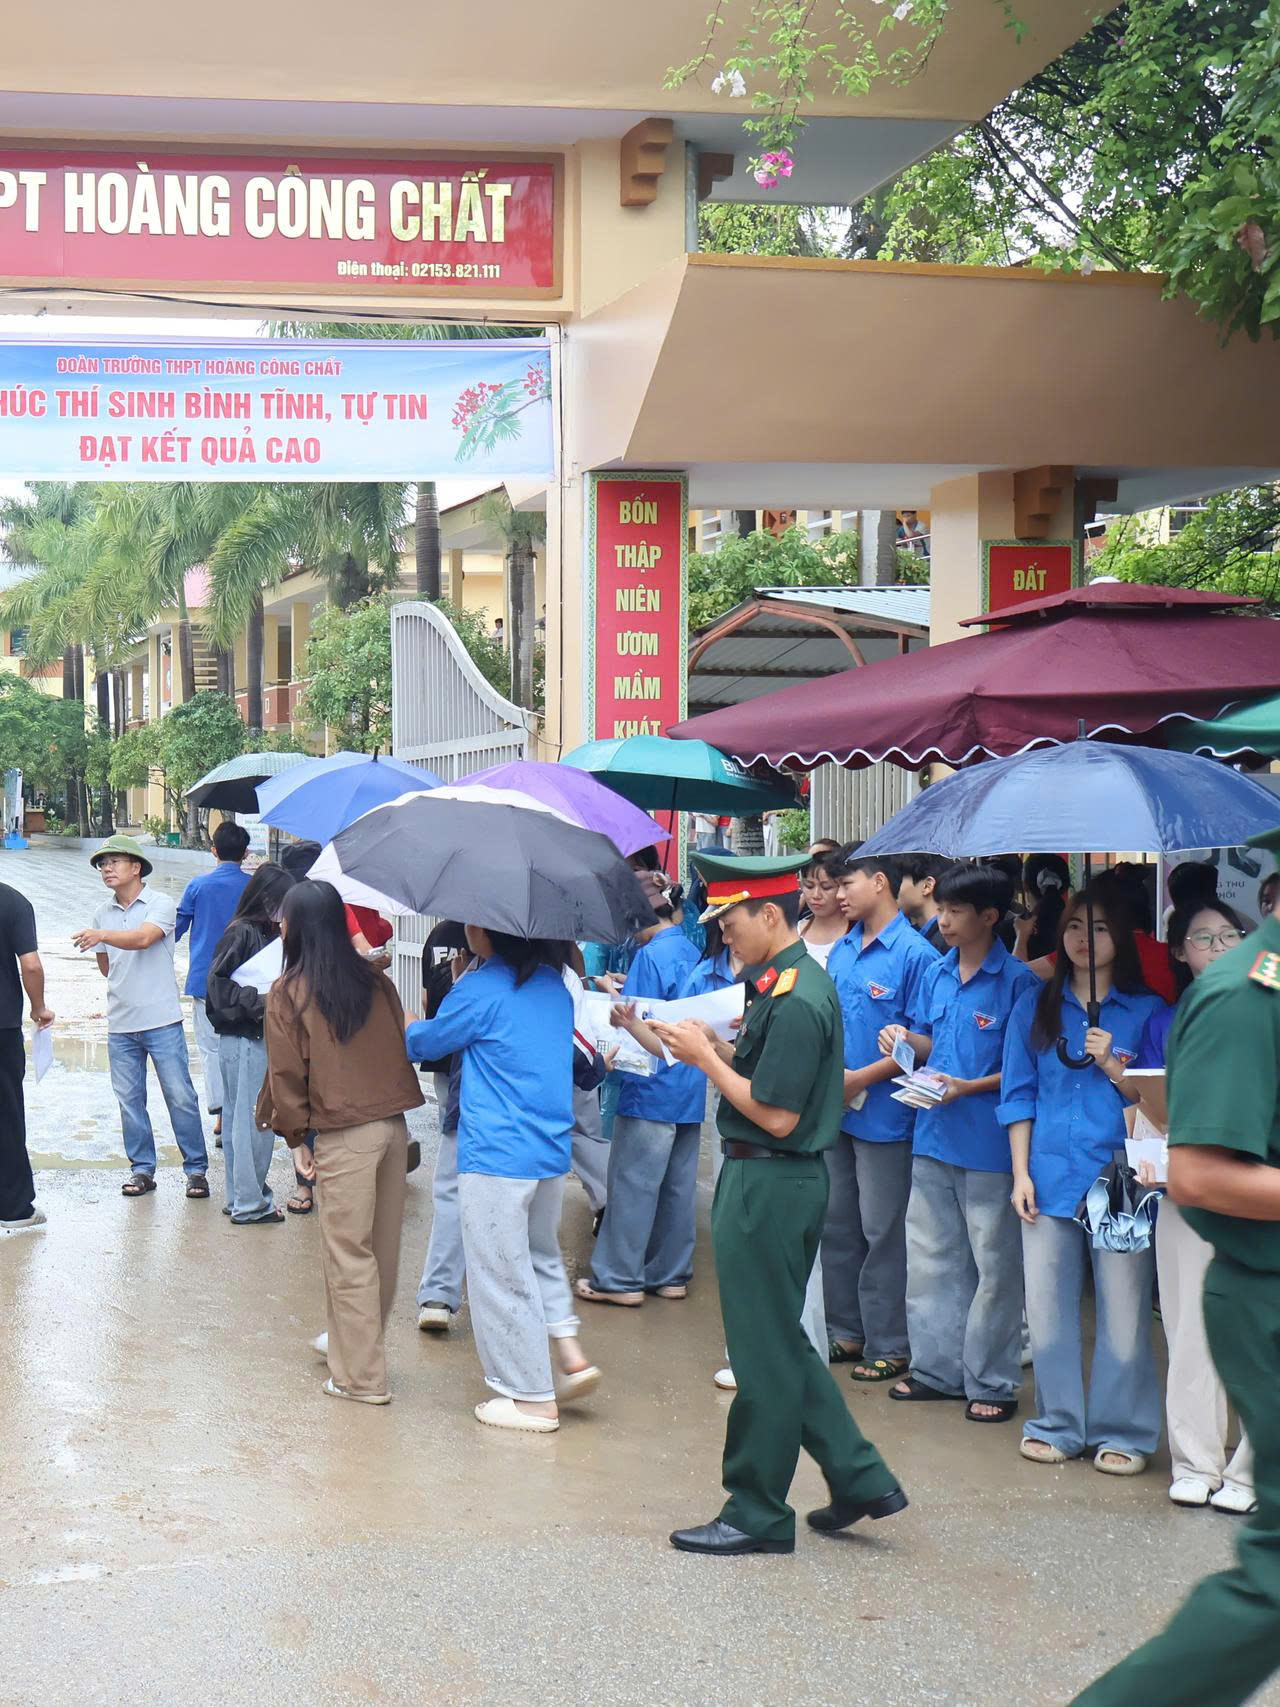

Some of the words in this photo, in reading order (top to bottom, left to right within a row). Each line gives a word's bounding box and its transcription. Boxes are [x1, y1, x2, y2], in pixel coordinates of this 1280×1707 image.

[64, 162, 231, 237] HOÀNG
[244, 164, 375, 242] CÔNG
[389, 168, 513, 243] CHẤT
[337, 260, 367, 279] Điện
[371, 262, 408, 280] thoại:
[411, 263, 500, 278] 02153.821.111
[57, 357, 98, 374] ĐOÀN
[103, 356, 161, 375] TRƯỜNG
[166, 360, 201, 375] THPT
[206, 359, 255, 376] HOÀNG
[260, 360, 299, 376] CÔNG
[304, 357, 342, 376] CHẤT
[56, 386, 98, 417] THÍ
[108, 392, 174, 419] SINH
[188, 386, 250, 420] BÌNH
[260, 390, 331, 424] TĨNH,
[341, 391, 378, 425] TỰ
[385, 393, 427, 420] TIN
[79, 436, 130, 466] ĐẠT
[142, 427, 191, 463] KẾT
[201, 426, 256, 466] QUẢ
[266, 437, 321, 463] CAO
[620, 493, 658, 524] BỐN
[615, 541, 662, 573] THẬP
[1014, 562, 1047, 591] ĐẤT
[616, 584, 660, 612] NIÊN
[617, 630, 658, 656] ƯƠM
[614, 668, 661, 700] MẦM
